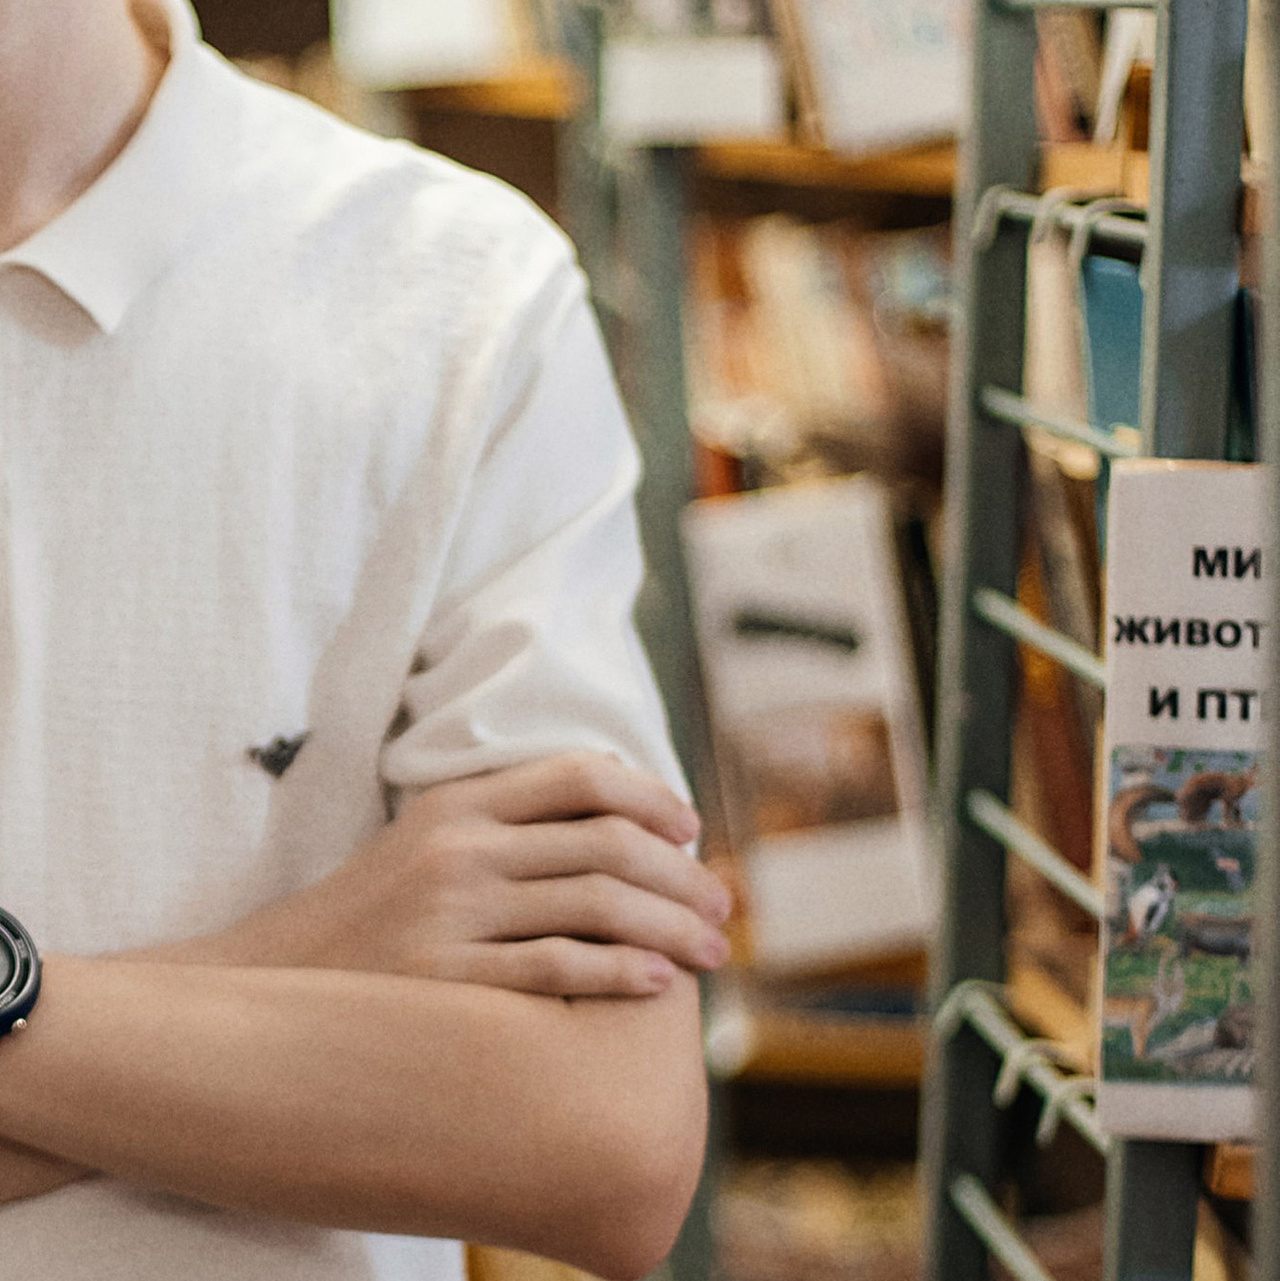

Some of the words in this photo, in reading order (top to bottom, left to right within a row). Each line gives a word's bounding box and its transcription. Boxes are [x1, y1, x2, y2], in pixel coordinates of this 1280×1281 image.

[1192, 546, 1262, 580] МИ
[1114, 615, 1264, 648] ЖИВОТ
[1148, 686, 1180, 720] И
[1196, 688, 1258, 721] ПТ
